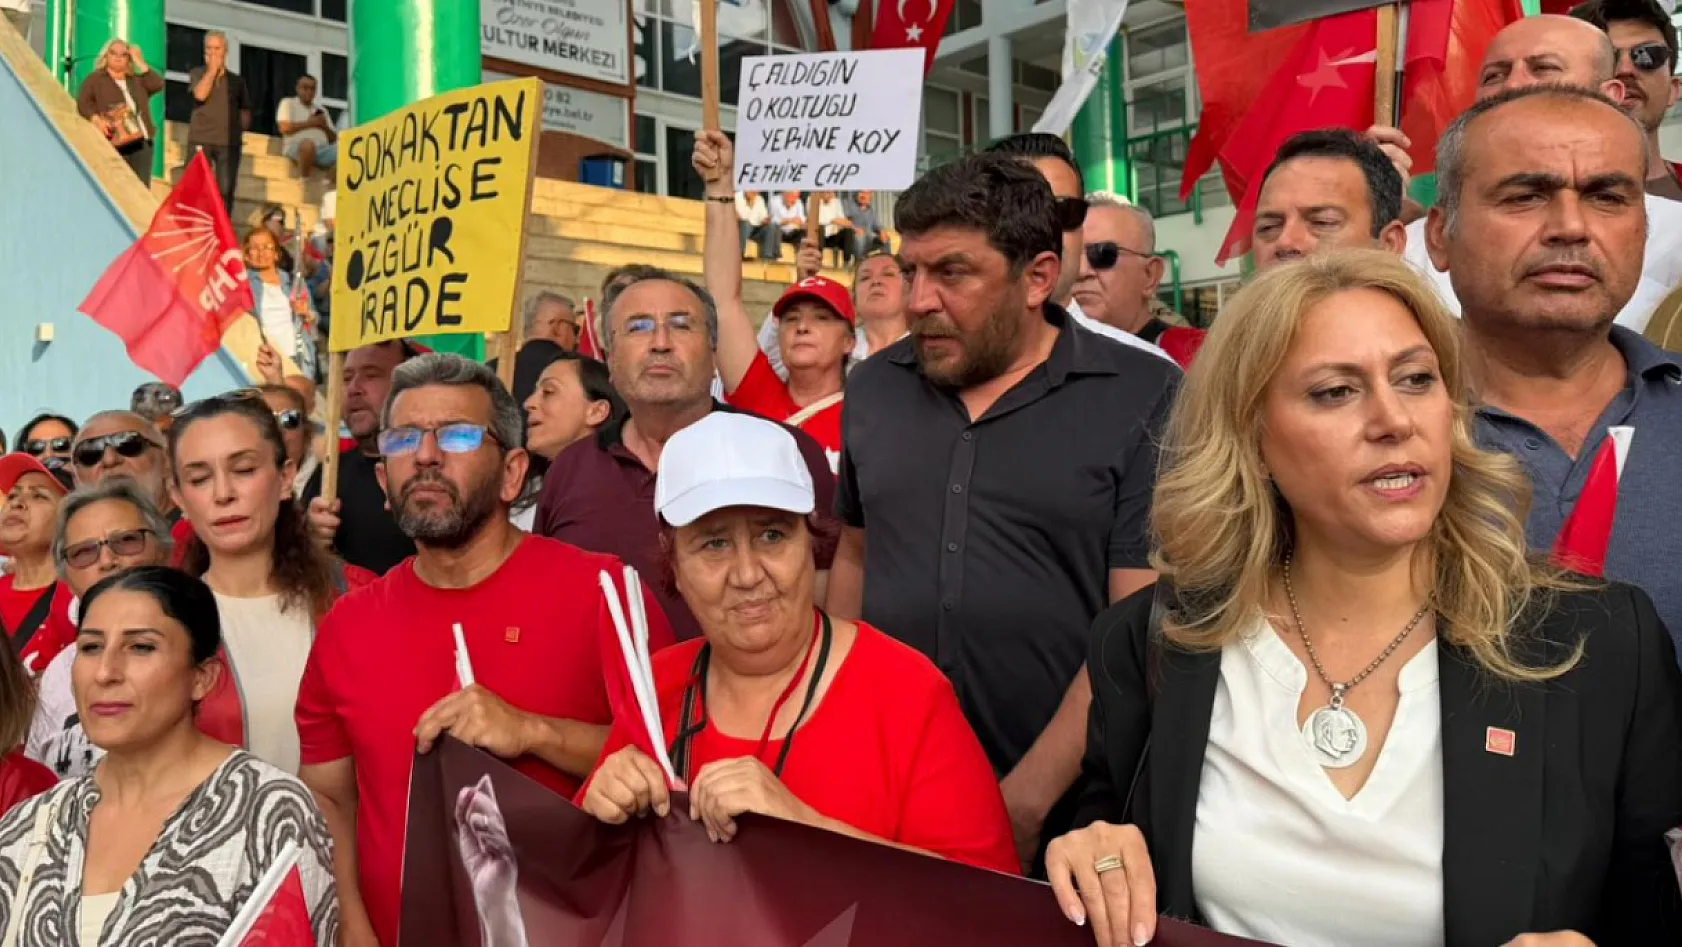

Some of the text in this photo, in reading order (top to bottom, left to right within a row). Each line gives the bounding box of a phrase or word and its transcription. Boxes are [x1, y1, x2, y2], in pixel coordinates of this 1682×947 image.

[746, 97, 762, 121] O
[346, 89, 525, 190] SOKAKTAN
[848, 127, 902, 154] KOY
[738, 158, 860, 187] FETHİYE CHP
[346, 216, 455, 291] ÖZGÜR
